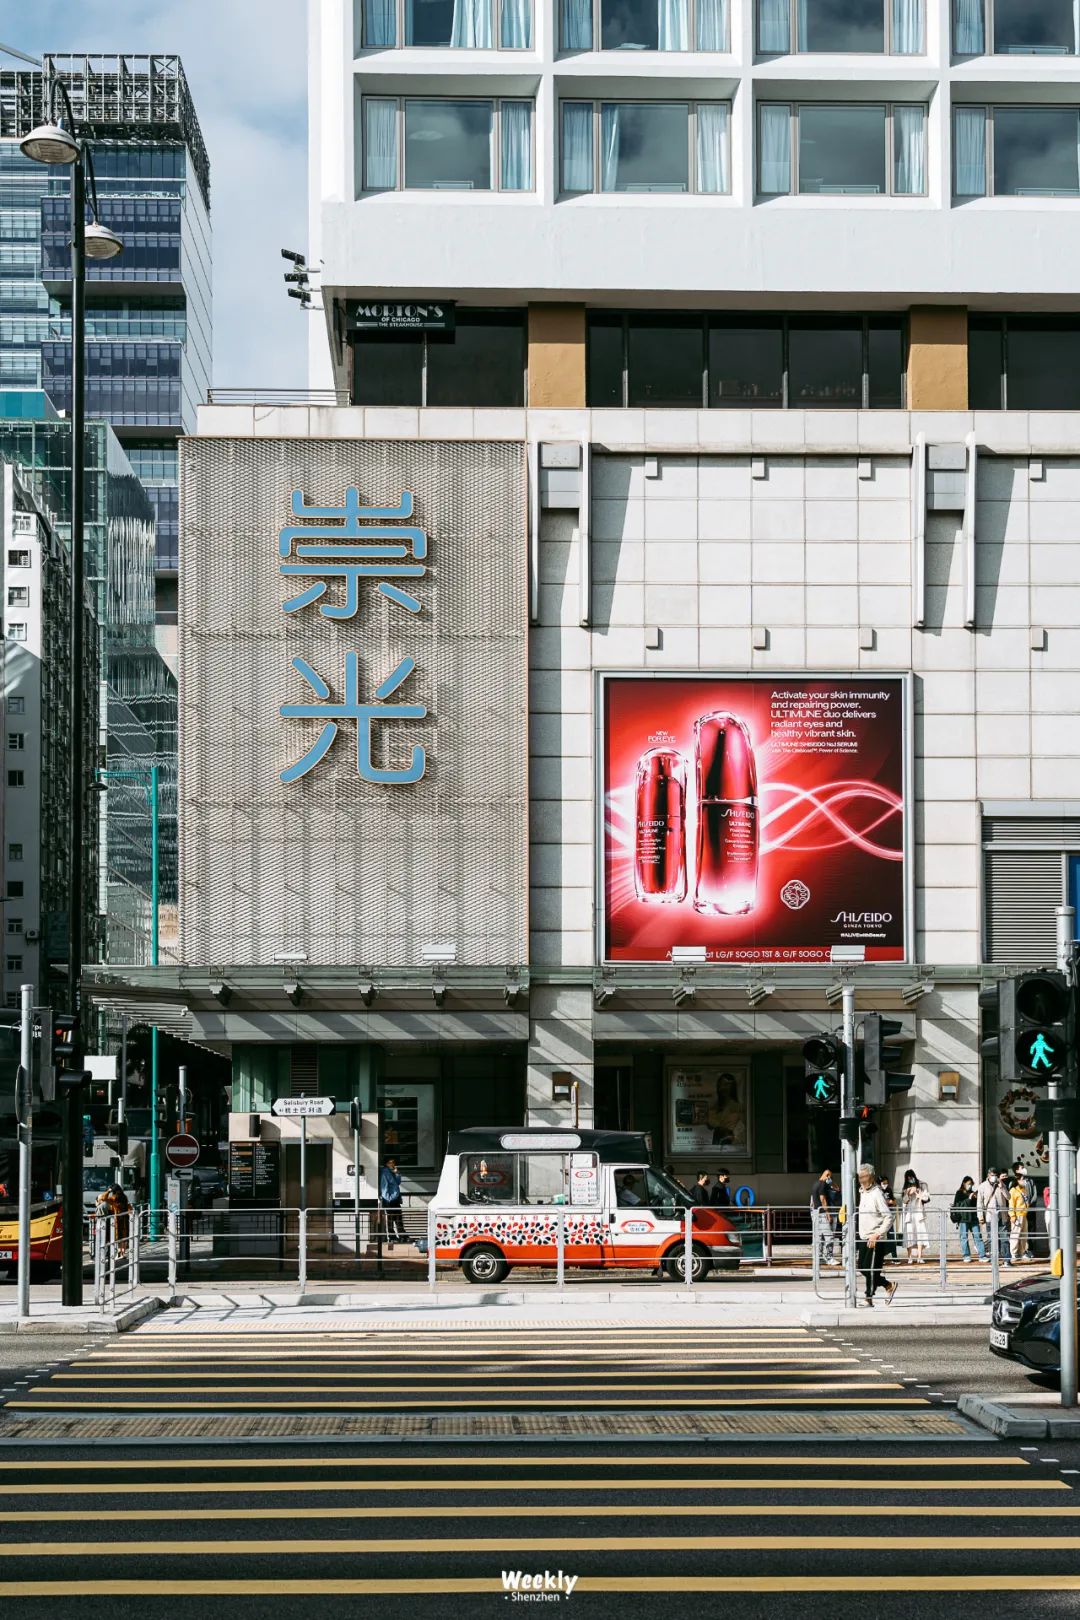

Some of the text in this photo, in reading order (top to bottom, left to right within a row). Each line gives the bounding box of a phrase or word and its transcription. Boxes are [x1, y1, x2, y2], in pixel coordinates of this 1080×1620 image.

[356, 305, 443, 317] MORTON'S
[279, 486, 427, 784] 崇光
[771, 691, 890, 701] Activate your skin immunity
[771, 701, 861, 710] and repairing power.
[771, 710, 877, 718] ULTIMUNE duo delivers
[771, 720, 843, 729] radiant eyes and
[771, 730, 804, 739] healthy
[721, 809, 755, 819] SHISEIDO
[830, 911, 892, 923] SHISEIDO
[761, 950, 774, 958] TST
[774, 950, 781, 958] &
[782, 950, 798, 958] G/F
[798, 950, 823, 958] SOGO
